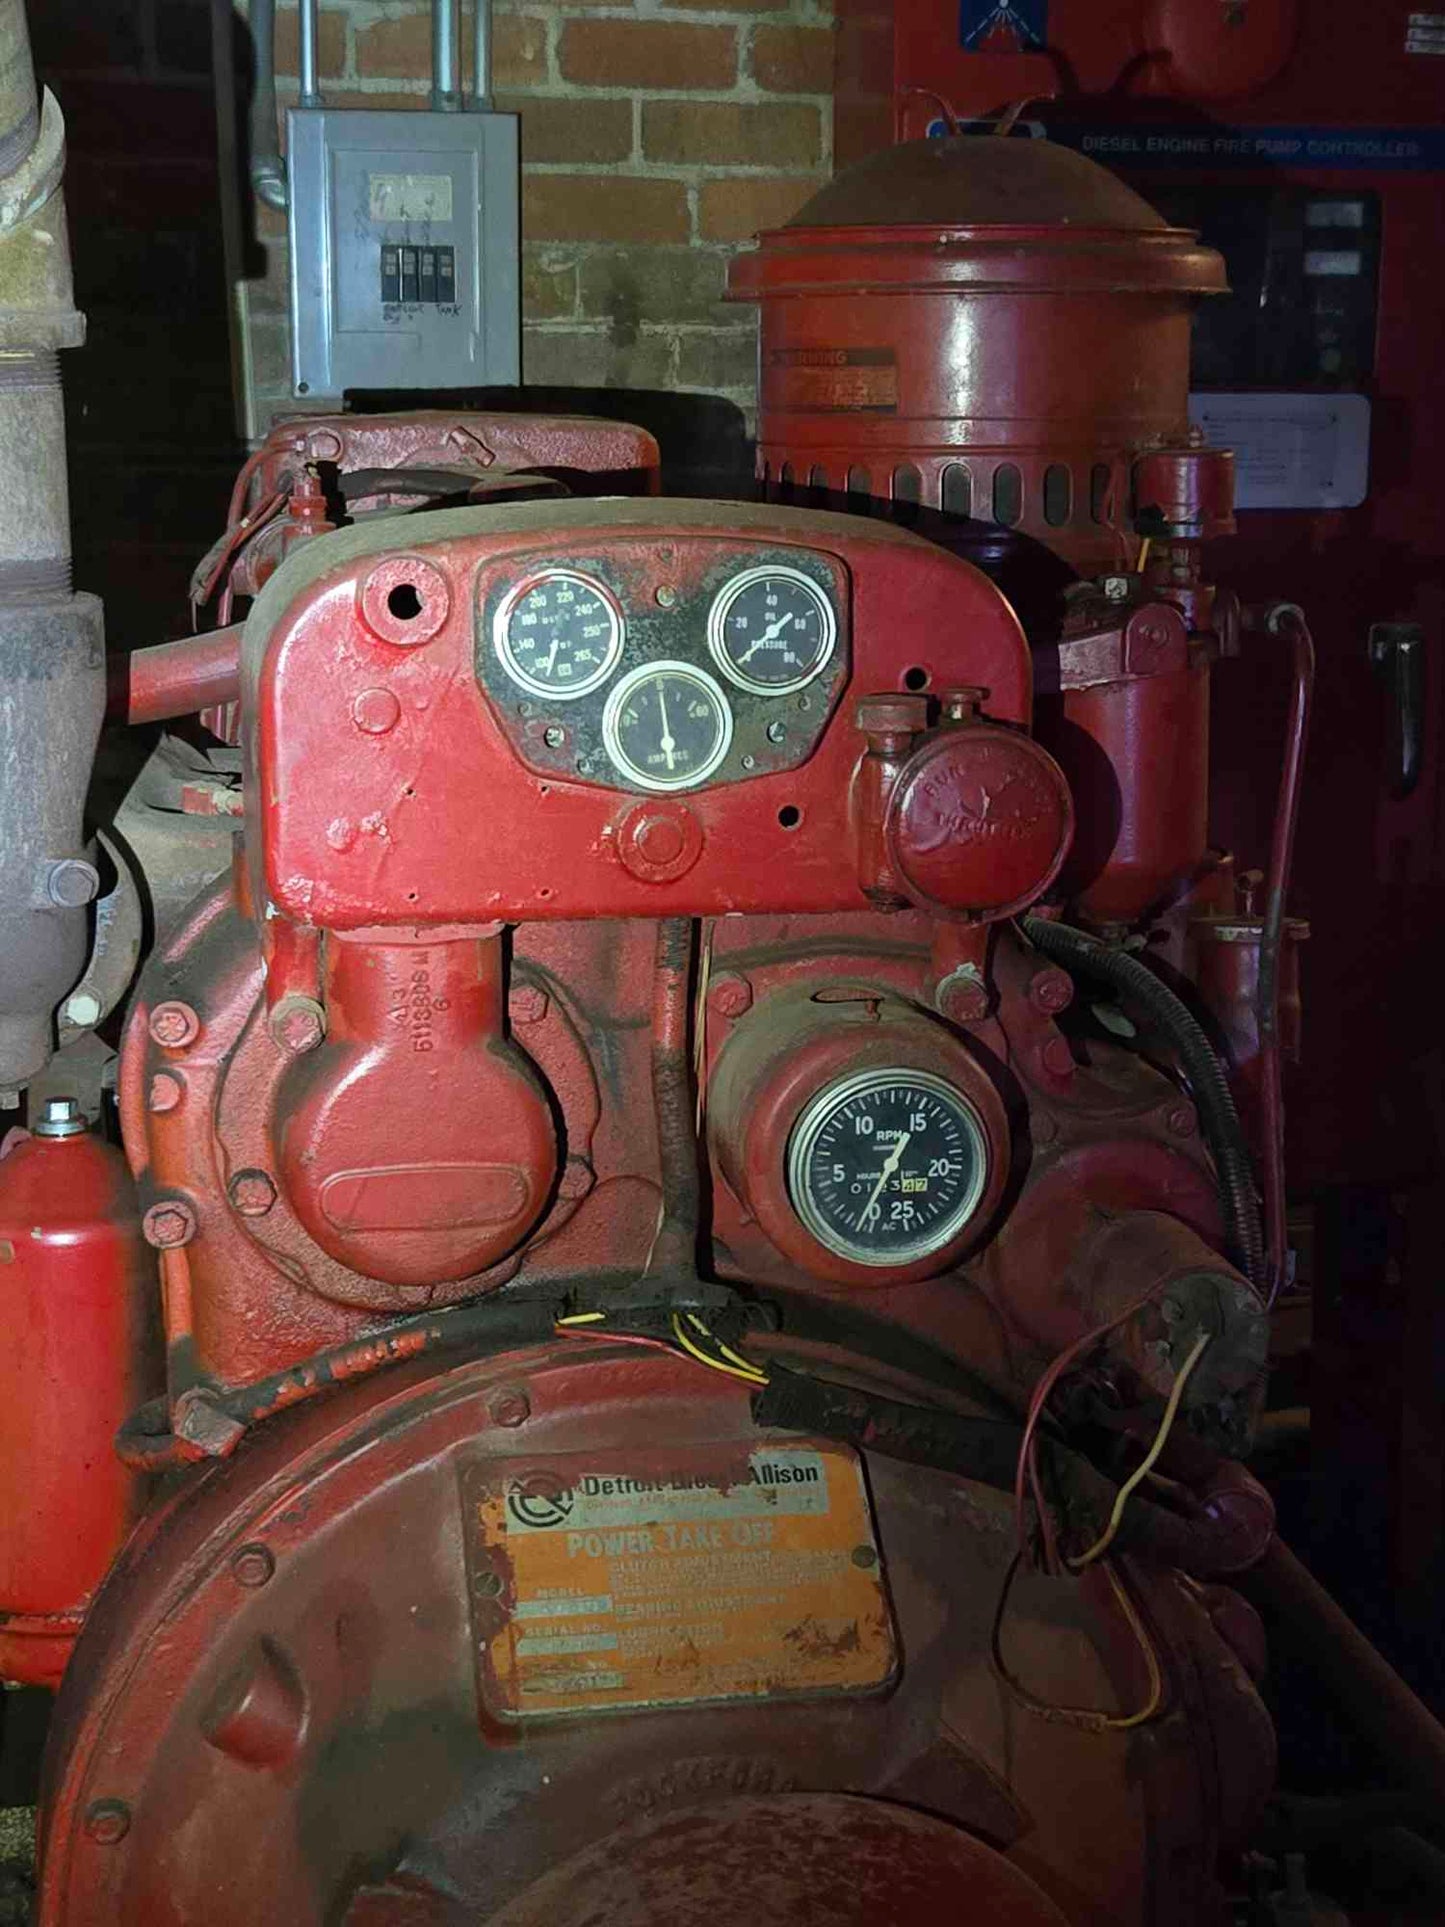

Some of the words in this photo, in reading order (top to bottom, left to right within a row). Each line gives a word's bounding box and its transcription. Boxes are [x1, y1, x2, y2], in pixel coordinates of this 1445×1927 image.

[1082, 136, 1139, 151] DIESEL
[1147, 137, 1209, 151] ENGINE
[530, 595, 547, 609] 200
[556, 591, 574, 603] 220
[575, 603, 593, 616] 240
[855, 1116, 874, 1135] 10
[910, 1113, 927, 1132] 15
[833, 1164, 845, 1182] 5
[928, 1159, 949, 1177] 20
[890, 1200, 914, 1219] 25
[567, 1531, 653, 1559] POWER
[662, 1523, 723, 1549] TAKE
[536, 1587, 585, 1599] MODEL
